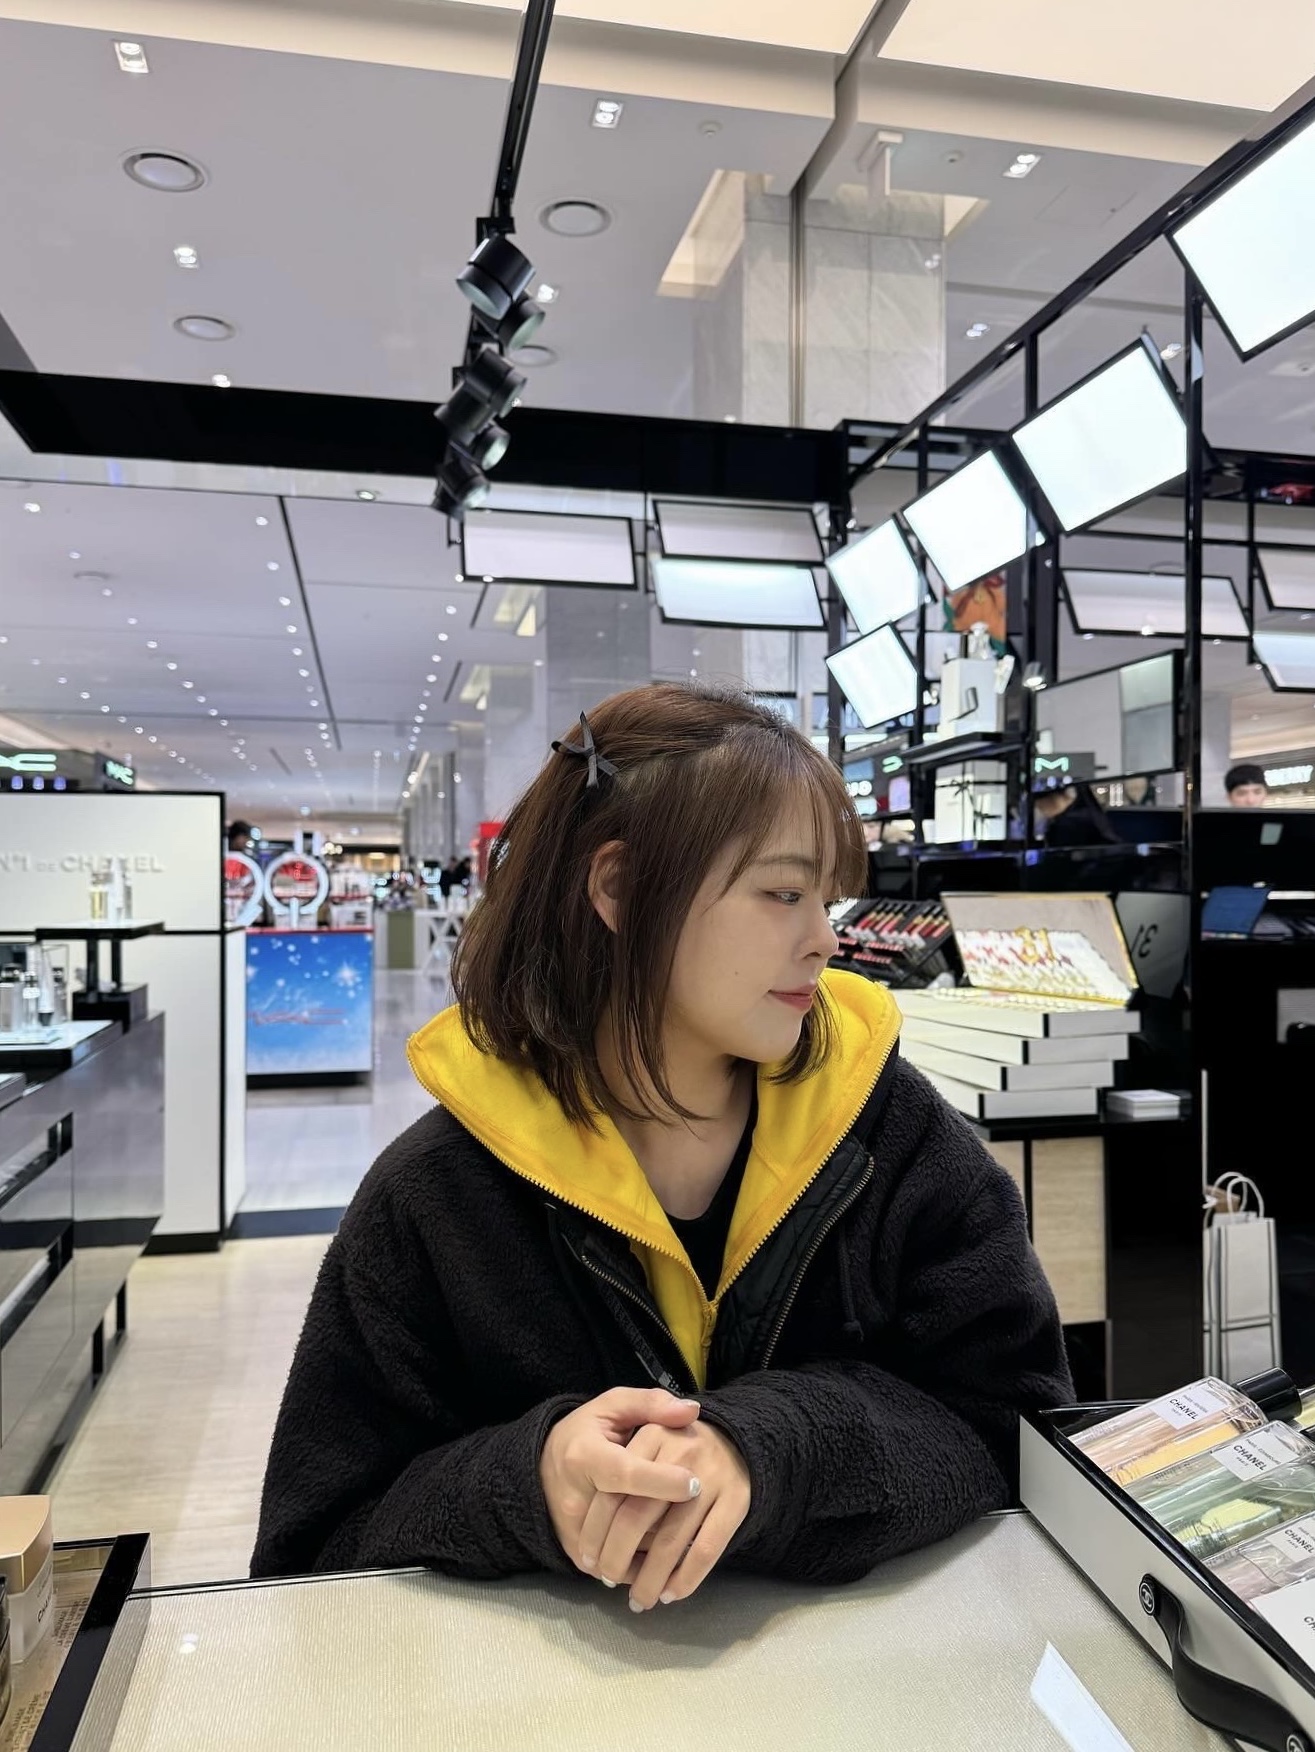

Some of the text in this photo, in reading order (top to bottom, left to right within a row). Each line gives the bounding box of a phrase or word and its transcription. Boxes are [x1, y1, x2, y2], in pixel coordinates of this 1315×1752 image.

[1169, 1398, 1199, 1420] CHANEL
[1233, 1445, 1267, 1471] CHANEL
[1284, 1529, 1314, 1554] CHANEL
